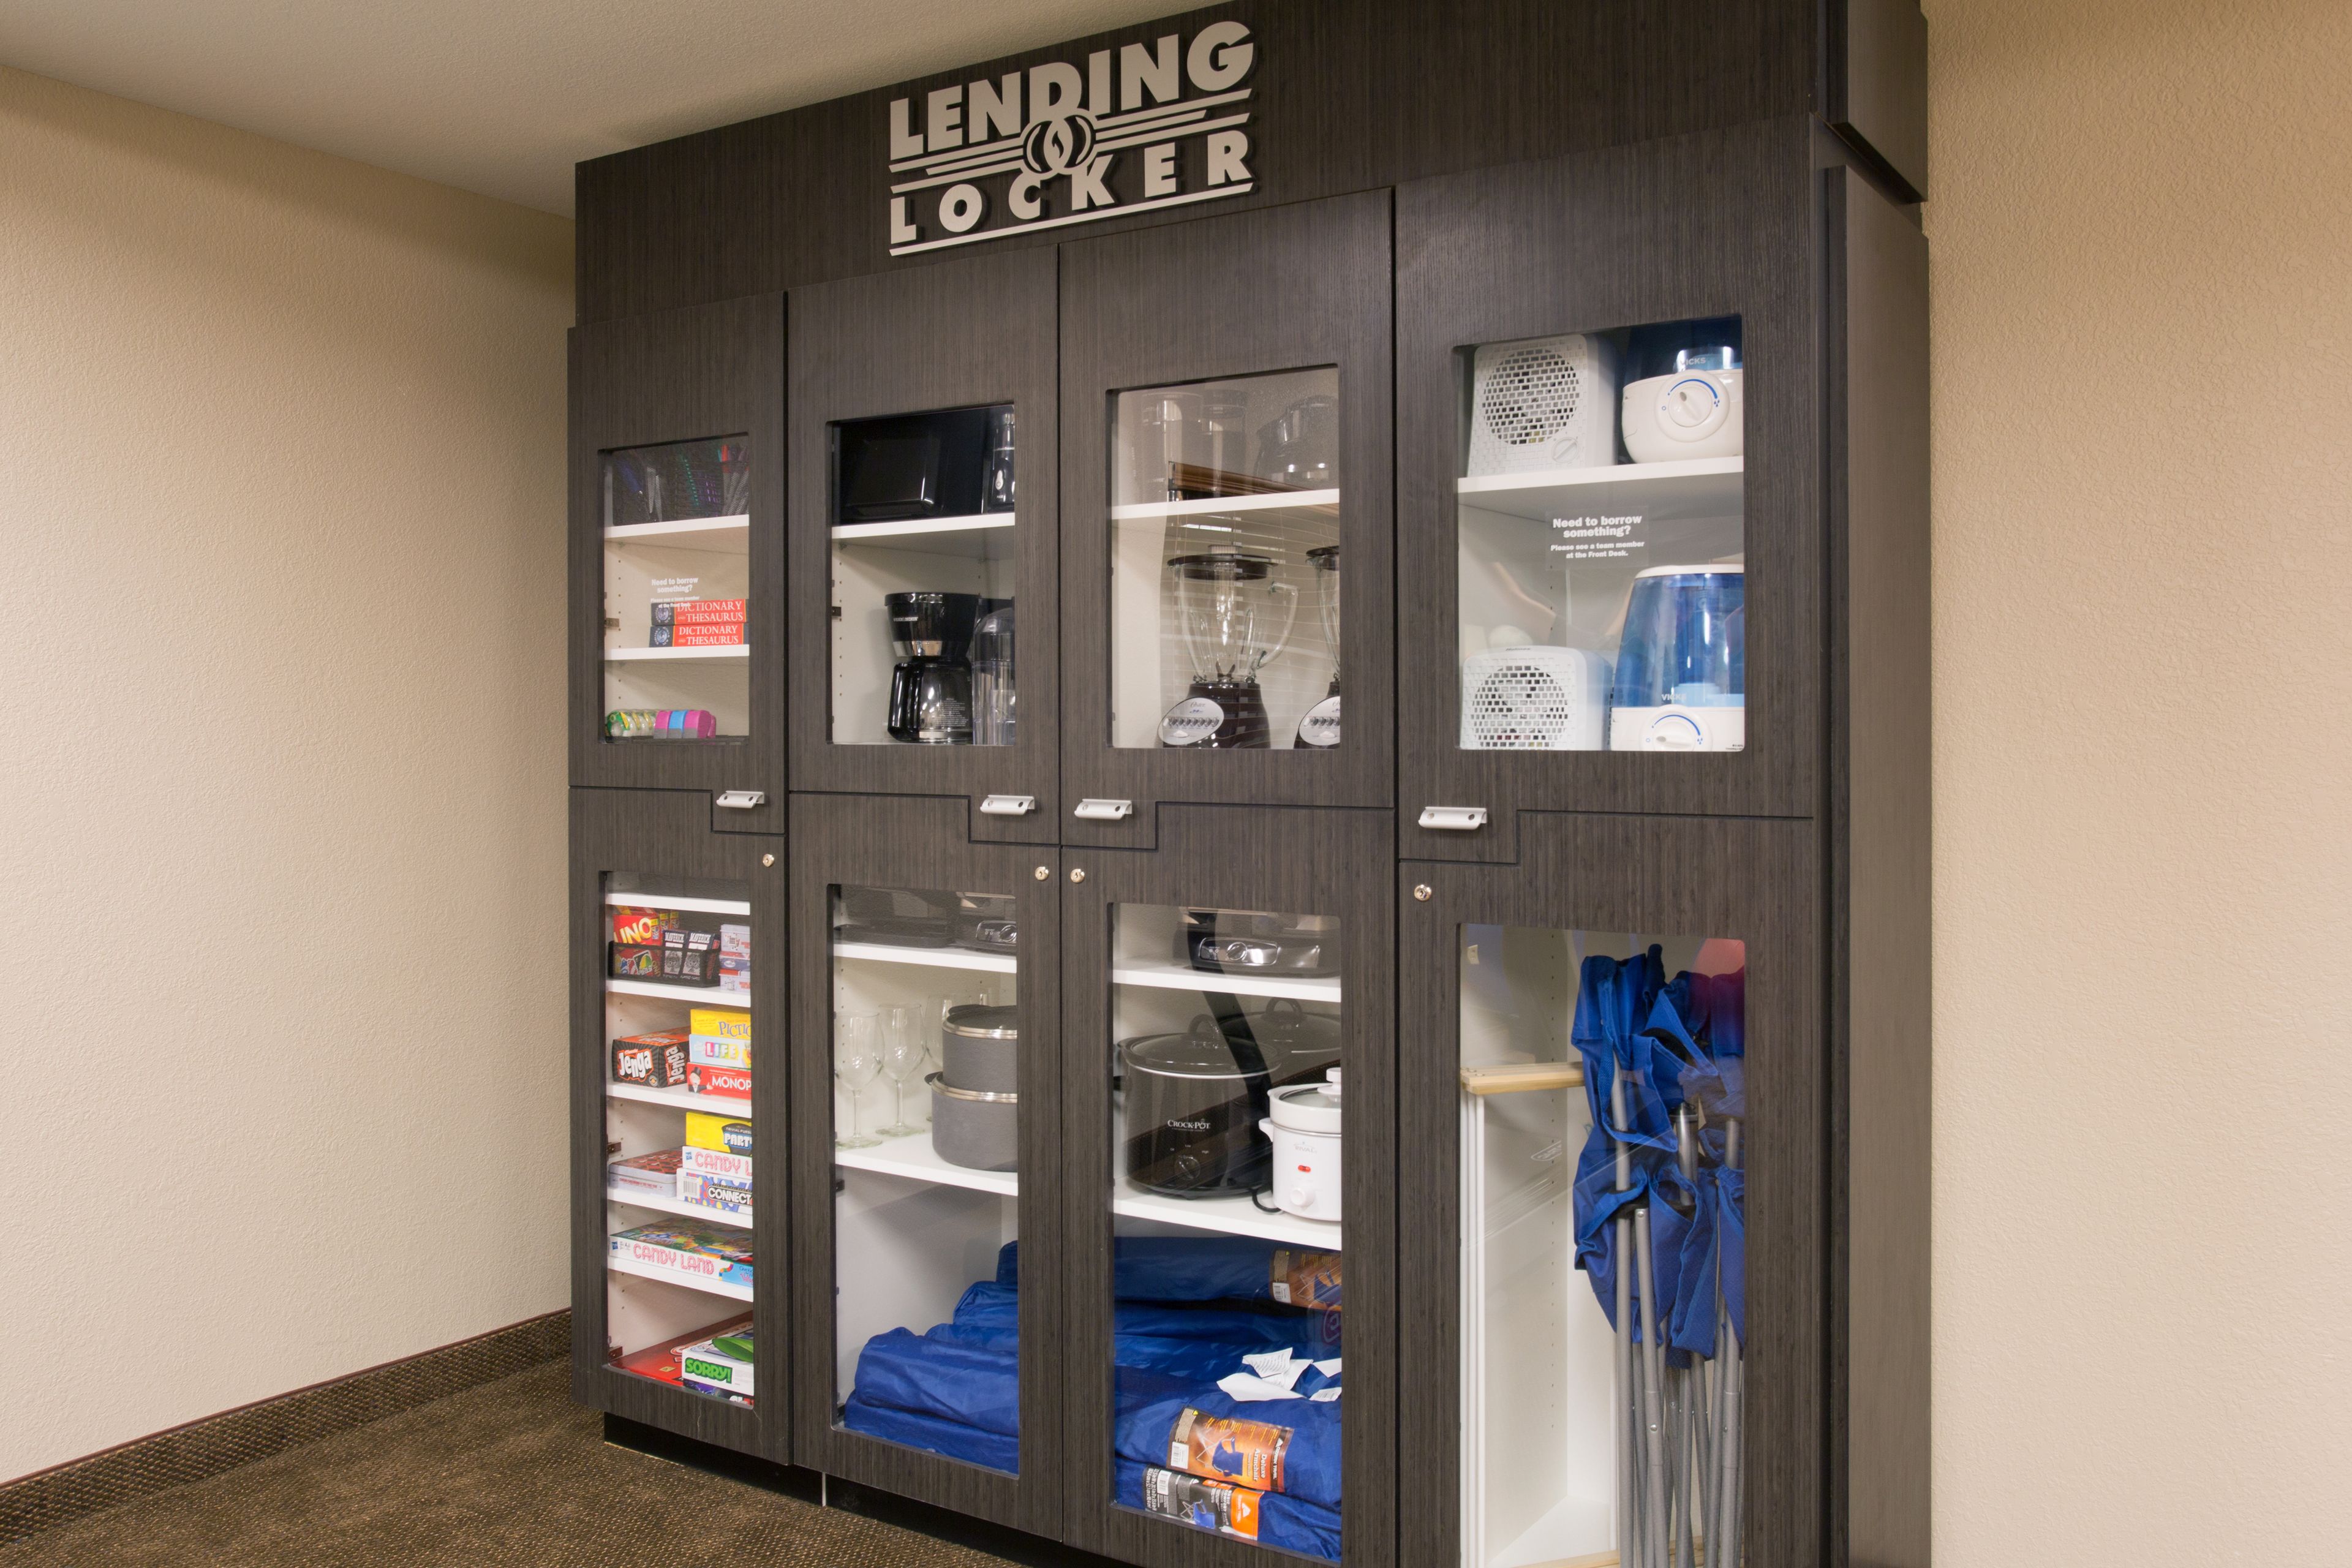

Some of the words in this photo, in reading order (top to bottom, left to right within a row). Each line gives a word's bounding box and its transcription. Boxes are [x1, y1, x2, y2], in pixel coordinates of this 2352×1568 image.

[890, 21, 1254, 160] LENDING
[890, 130, 1253, 244] LOCKER
[1553, 518, 1583, 528] Need
[1585, 516, 1598, 526] to
[1600, 516, 1642, 526] borrow
[1563, 526, 1631, 538] something?
[657, 584, 693, 593] something?
[677, 601, 742, 612] DICTIONARY
[686, 612, 744, 622] THESAURUS
[679, 625, 738, 635] DICTIONARY
[687, 636, 739, 645] THESAURUS
[706, 1042, 737, 1059] LIFE
[619, 1050, 652, 1078] Jenga
[666, 1046, 685, 1083] Jenga
[695, 1152, 741, 1174] CANDY
[708, 1187, 752, 1205] CONNECT
[633, 1243, 677, 1267] CANDY
[680, 1254, 715, 1275] LAND
